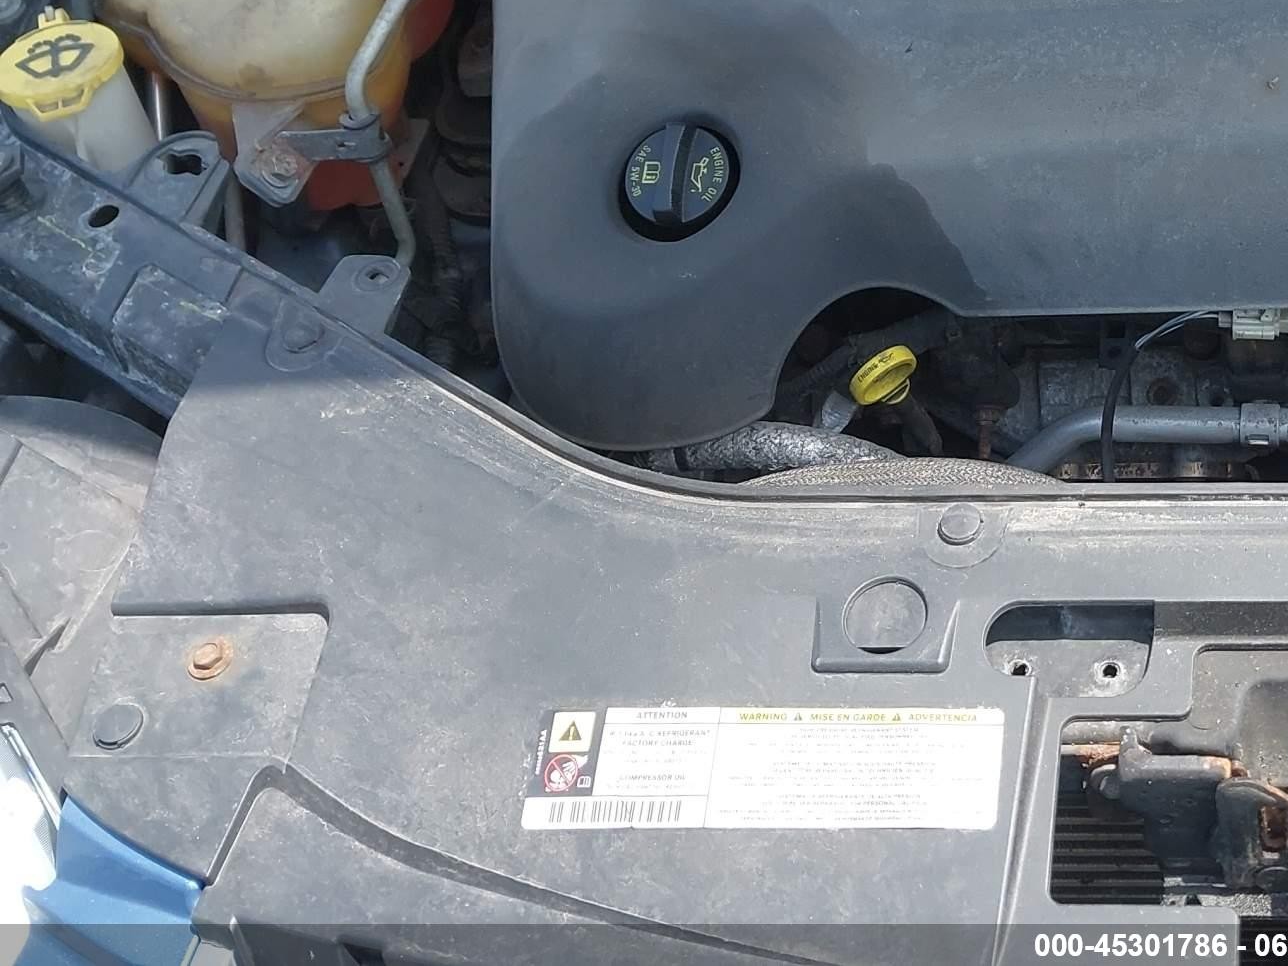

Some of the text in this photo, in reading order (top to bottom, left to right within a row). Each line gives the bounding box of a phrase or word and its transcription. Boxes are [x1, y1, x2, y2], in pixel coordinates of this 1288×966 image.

[630, 145, 652, 197] SAE 5W-30
[701, 146, 724, 202] ENGINE OIL
[636, 711, 688, 720] ATTENTION
[739, 712, 788, 721] WARNING
[810, 713, 833, 721] MISE
[852, 713, 887, 722] GARDE
[908, 713, 977, 722] ADVERTENCIA
